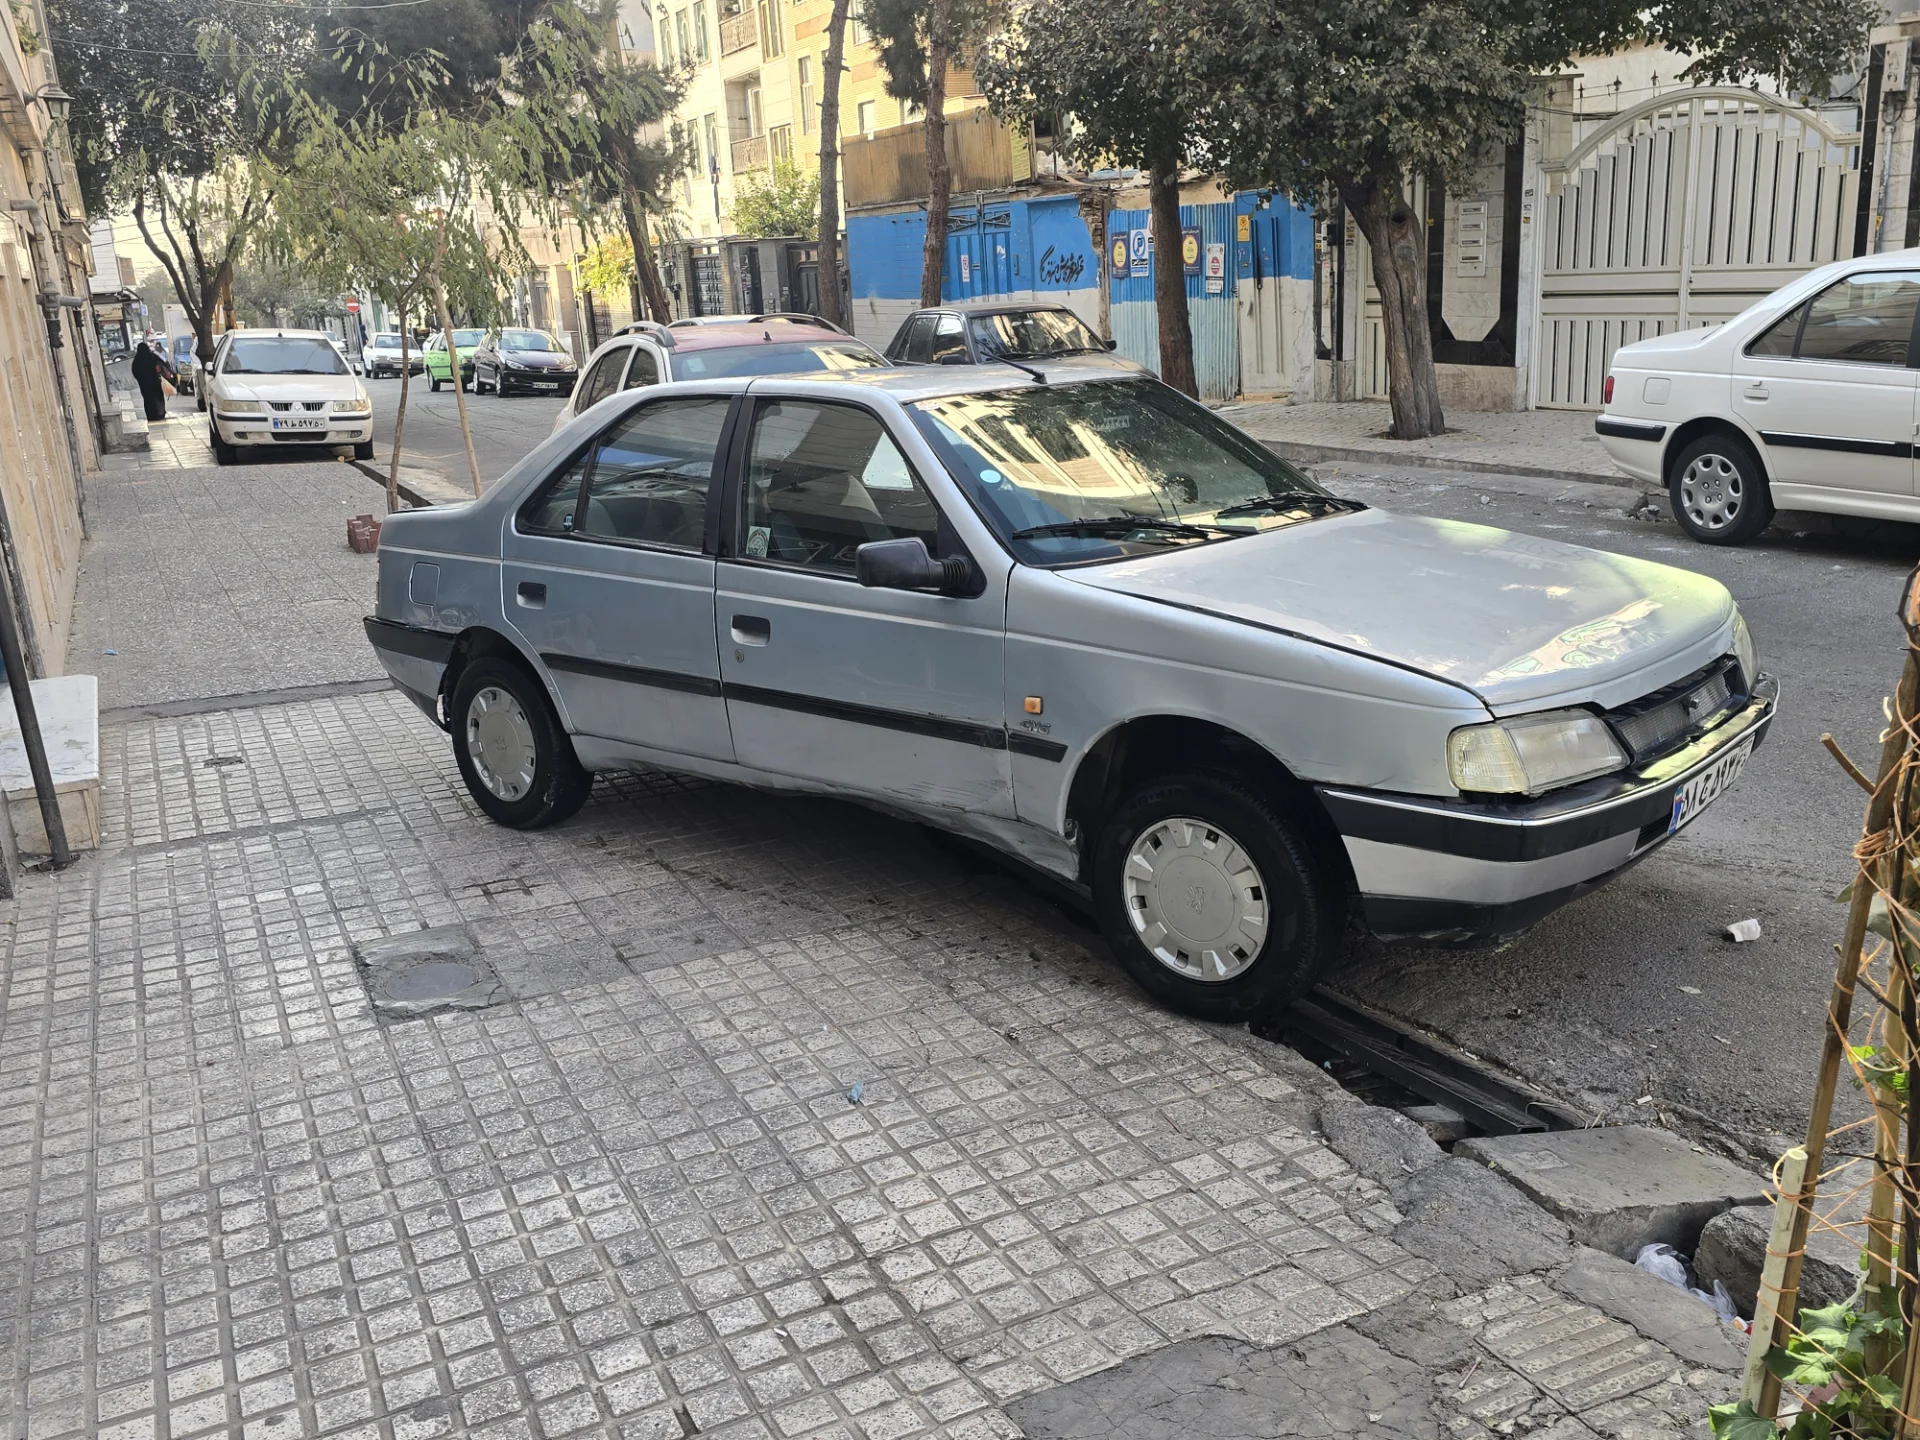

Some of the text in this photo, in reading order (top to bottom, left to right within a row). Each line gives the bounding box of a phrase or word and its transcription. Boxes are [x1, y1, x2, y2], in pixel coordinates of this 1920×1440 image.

[279, 419, 289, 427] ۷۹
[291, 419, 297, 427] ط
[298, 419, 313, 427] ۵۹۷
[1020, 719, 1052, 736] CNG
[1699, 773, 1713, 806] ج
